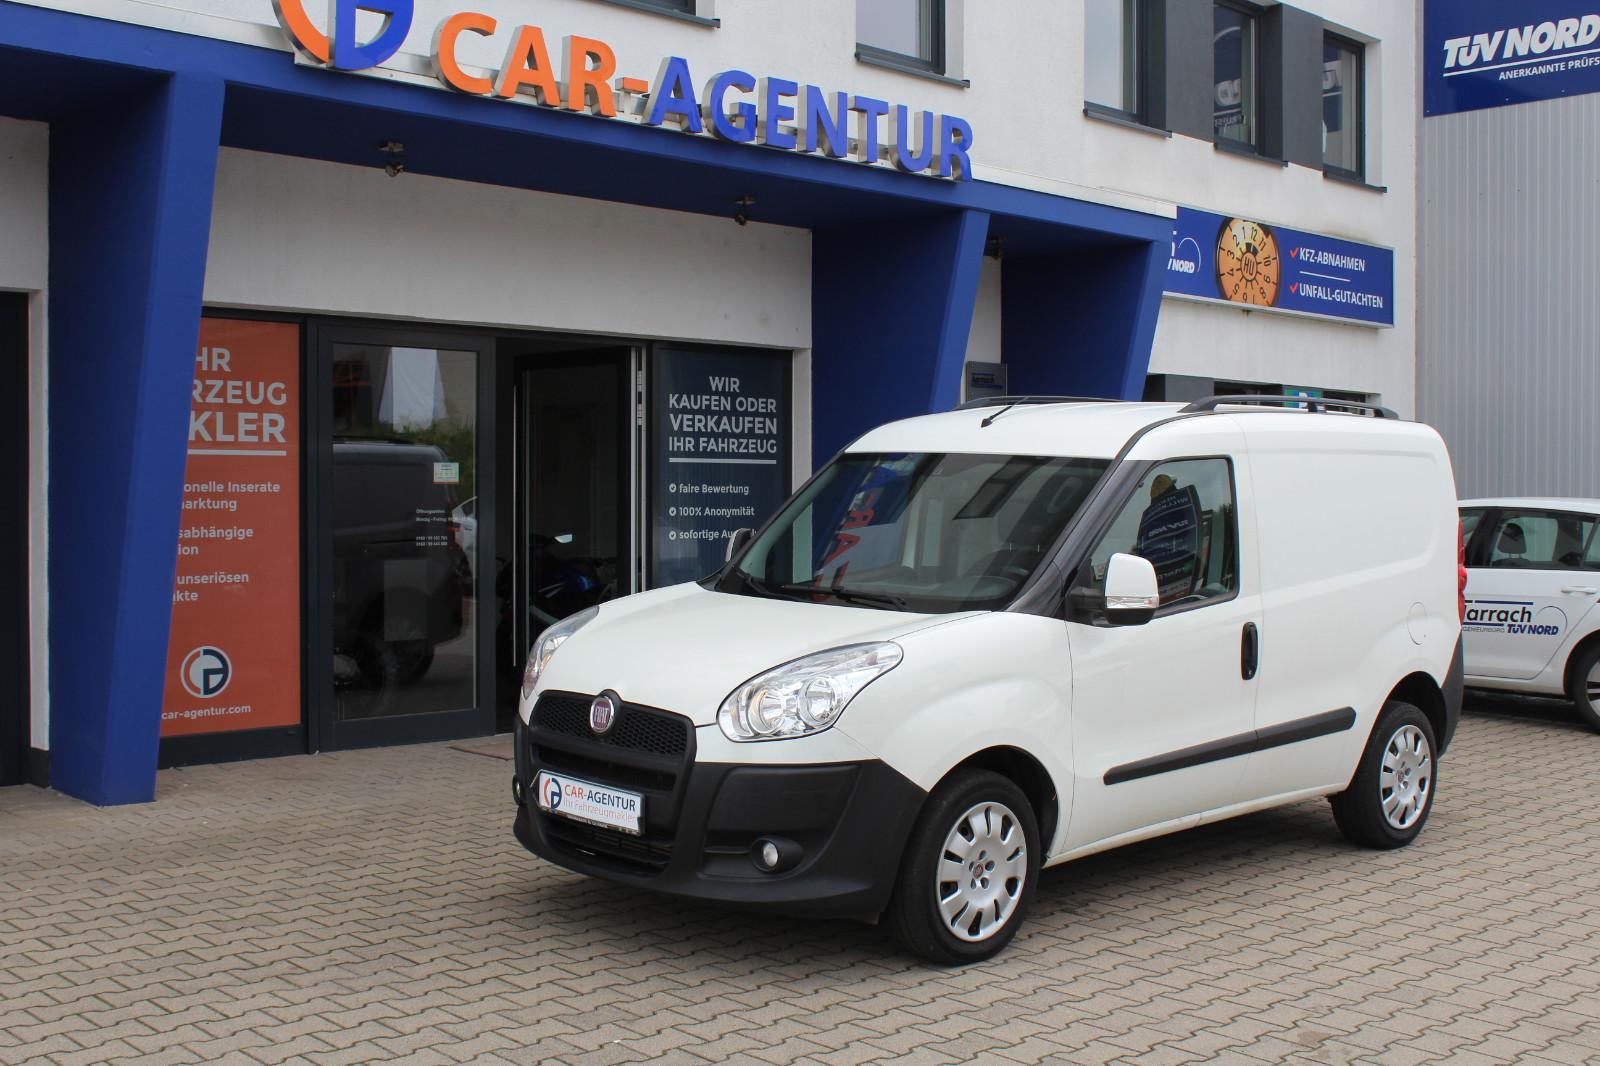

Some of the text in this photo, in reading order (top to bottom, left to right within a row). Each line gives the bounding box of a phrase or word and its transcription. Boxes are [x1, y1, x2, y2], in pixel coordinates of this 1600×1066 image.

[1443, 14, 1600, 69] TÜV NORD
[1499, 62, 1566, 80] ANERKANNTE
[432, 12, 974, 182] CAR-AGENTUR
[1232, 234, 1240, 247] 2
[1250, 226, 1258, 242] 12
[1227, 250, 1235, 260] 3
[1299, 247, 1365, 272] KFZ-ABNAHMEN
[1172, 259, 1195, 273] NORD
[1244, 256, 1255, 276] HU
[1299, 282, 1383, 309] UNFALL-GUTACHTEN
[708, 375, 740, 392] WIR
[669, 393, 776, 413] KAUFEN ODER
[669, 413, 777, 435] VERKAUFEN
[669, 437, 777, 453] IHR FAHRZEUG
[228, 481, 281, 493] Inserate
[679, 483, 749, 495] faire Bewertung
[679, 506, 755, 518] 100% Anonymität
[679, 529, 719, 541] sofortige
[177, 572, 249, 584] unseriösen
[1507, 623, 1528, 634] TÜV
[1528, 625, 1559, 636] NORD
[161, 704, 251, 719] car-agentur.com
[564, 784, 635, 812] CAR-AGENTUR
